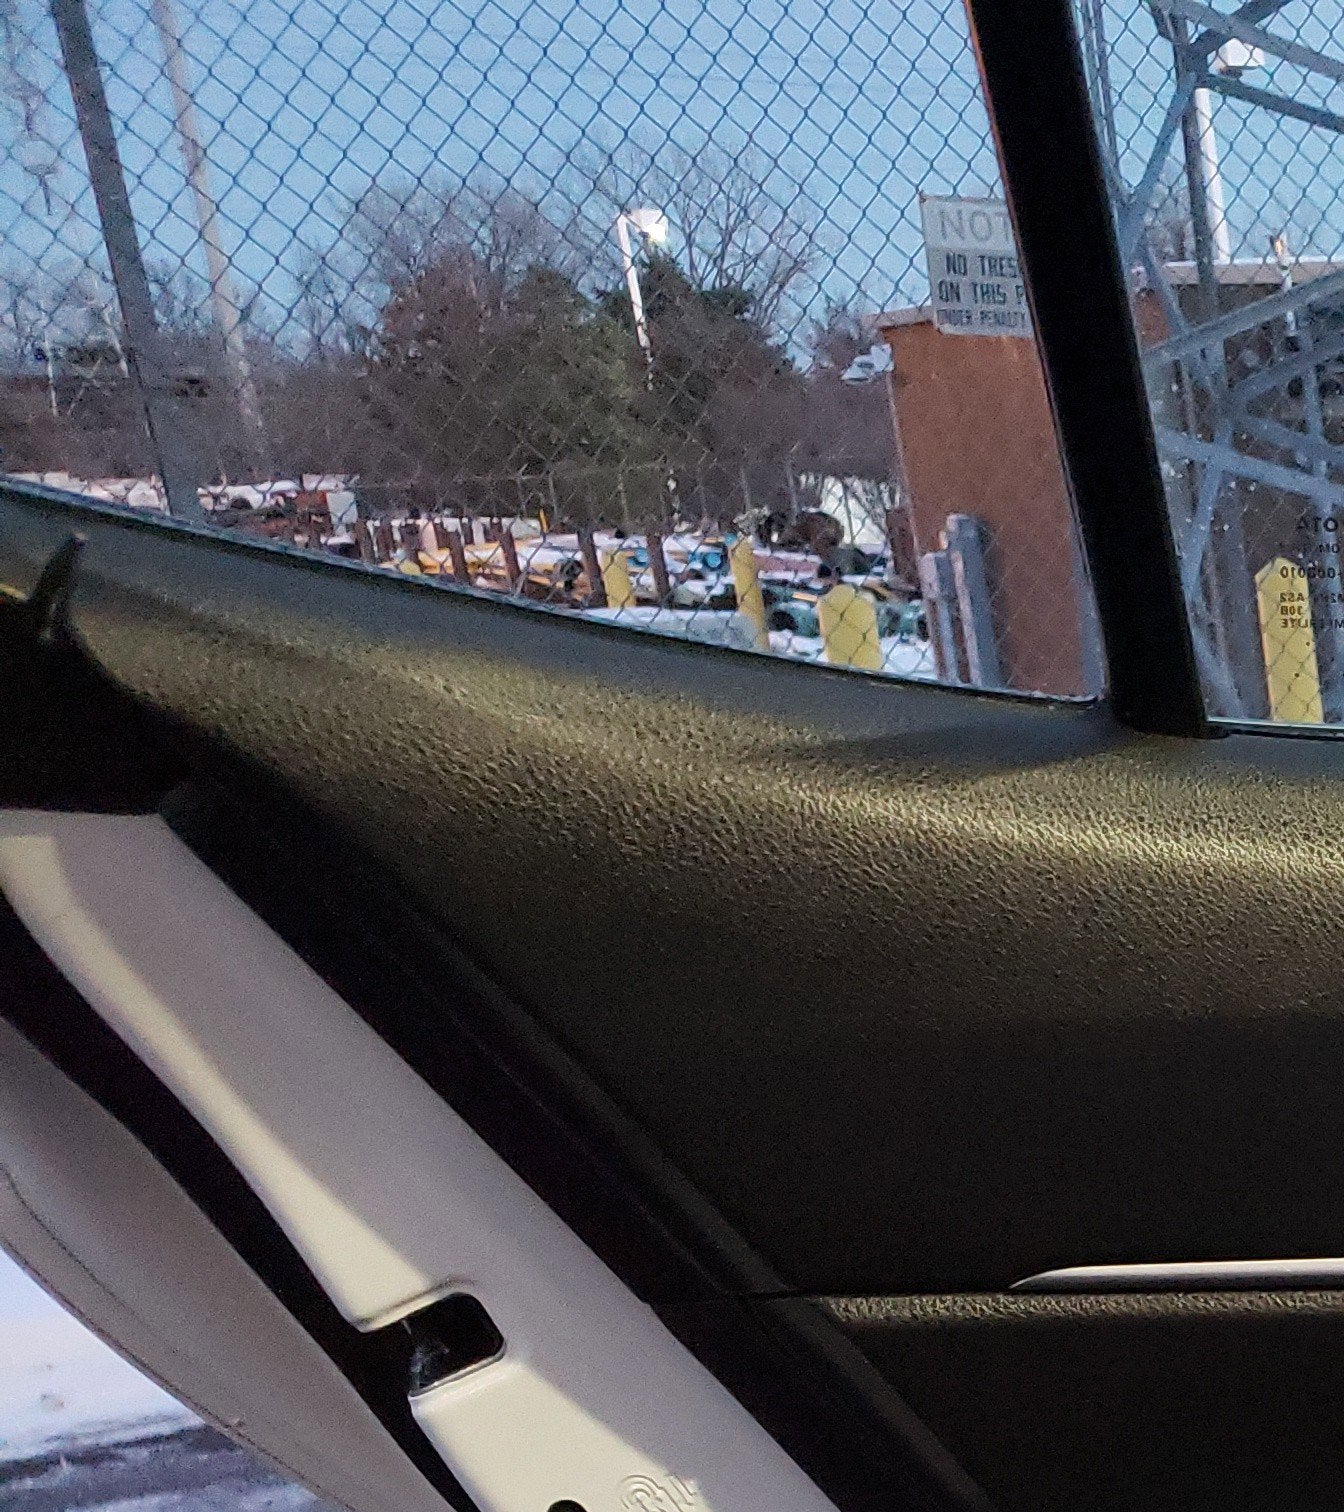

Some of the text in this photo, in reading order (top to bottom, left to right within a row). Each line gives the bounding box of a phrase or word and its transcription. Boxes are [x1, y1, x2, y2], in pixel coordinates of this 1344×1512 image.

[945, 250, 968, 277] NO
[938, 279, 962, 304] ON
[970, 281, 1007, 306] THIS
